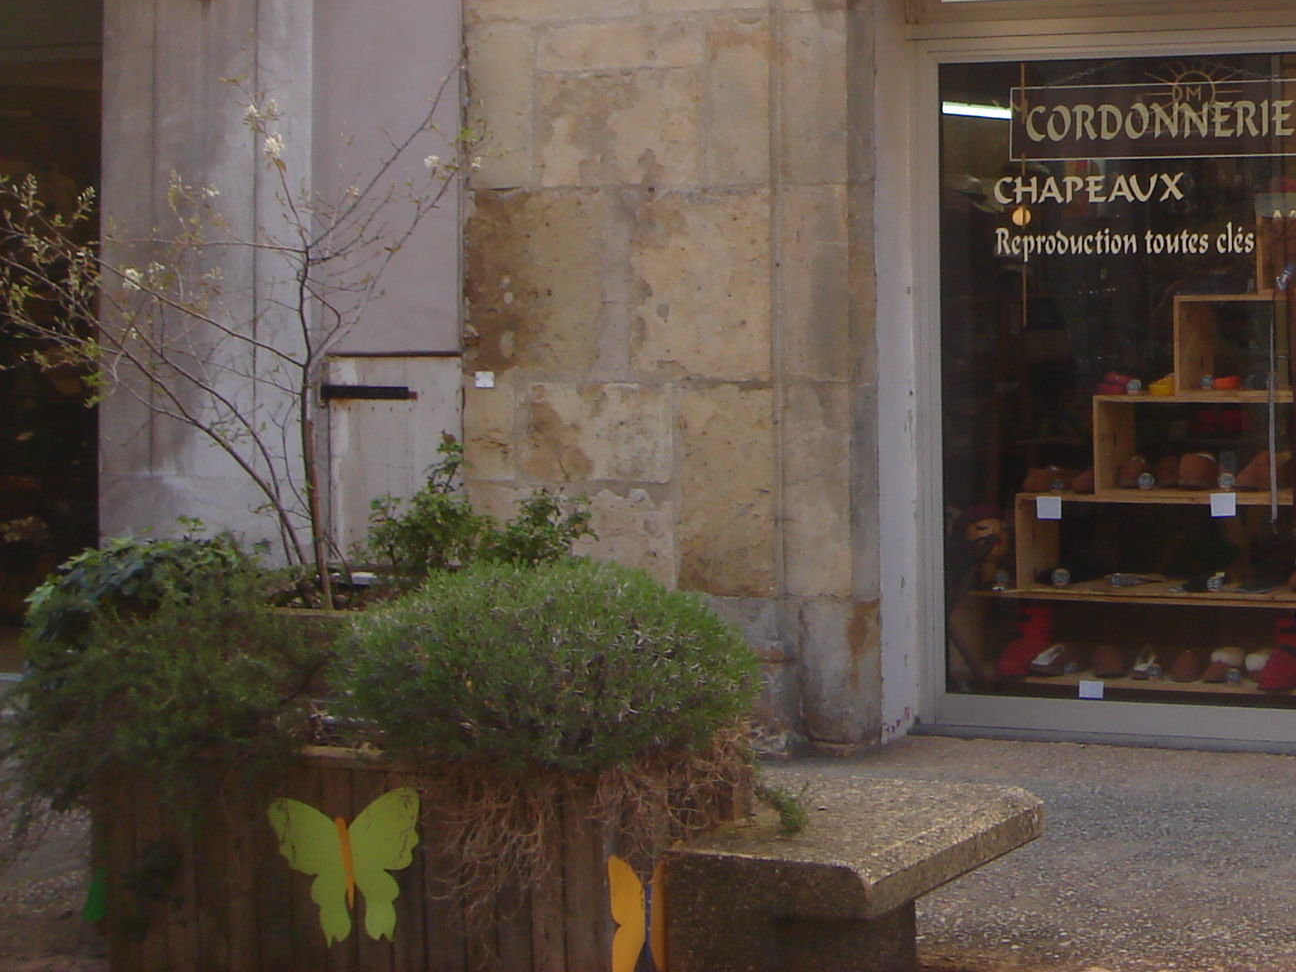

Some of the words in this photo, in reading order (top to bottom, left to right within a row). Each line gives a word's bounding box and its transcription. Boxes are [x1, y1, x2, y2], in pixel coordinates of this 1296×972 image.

[1026, 99, 1295, 142] CORDONNERIE
[993, 172, 1185, 204] CHAPEAUX
[994, 228, 1138, 263] Reproduction
[1144, 229, 1209, 254] toutes
[1216, 221, 1256, 254] clés
